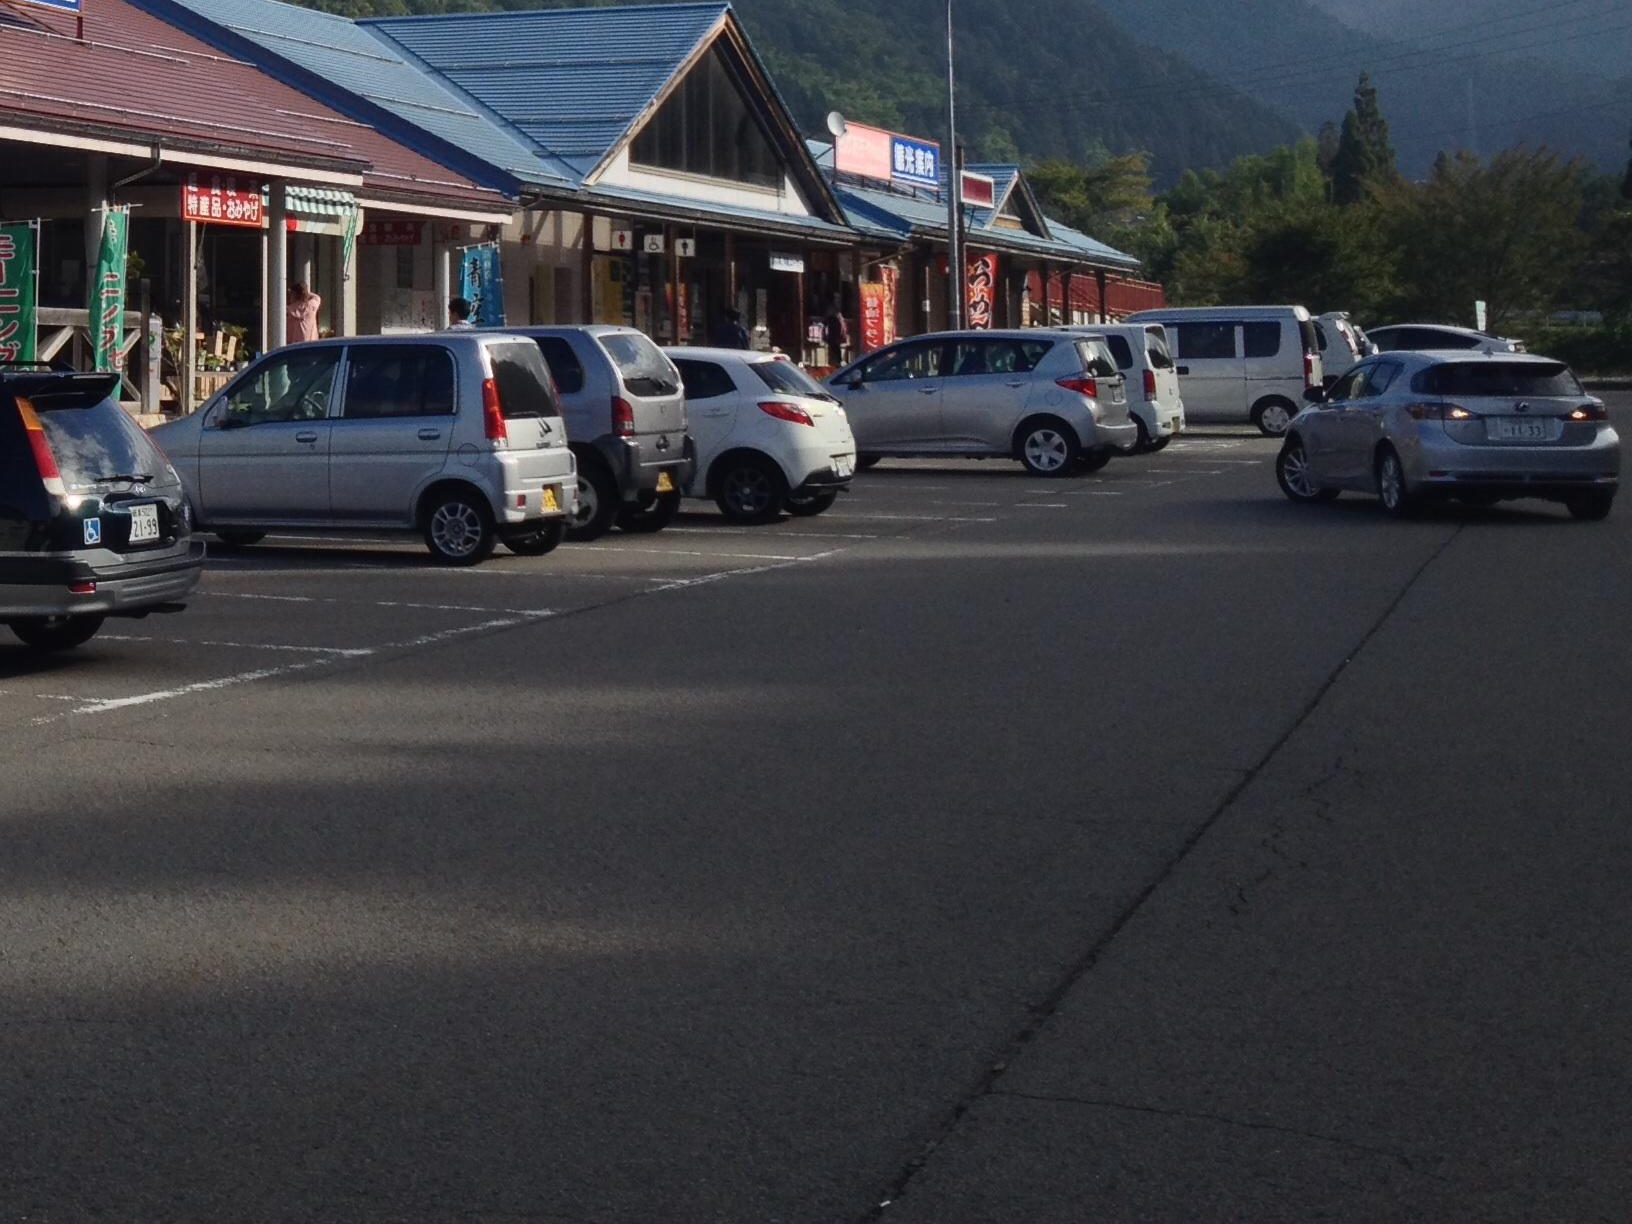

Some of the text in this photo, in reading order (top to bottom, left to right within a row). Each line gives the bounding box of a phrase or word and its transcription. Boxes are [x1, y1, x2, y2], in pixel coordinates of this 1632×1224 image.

[187, 193, 259, 222] 特産品・おみやげ
